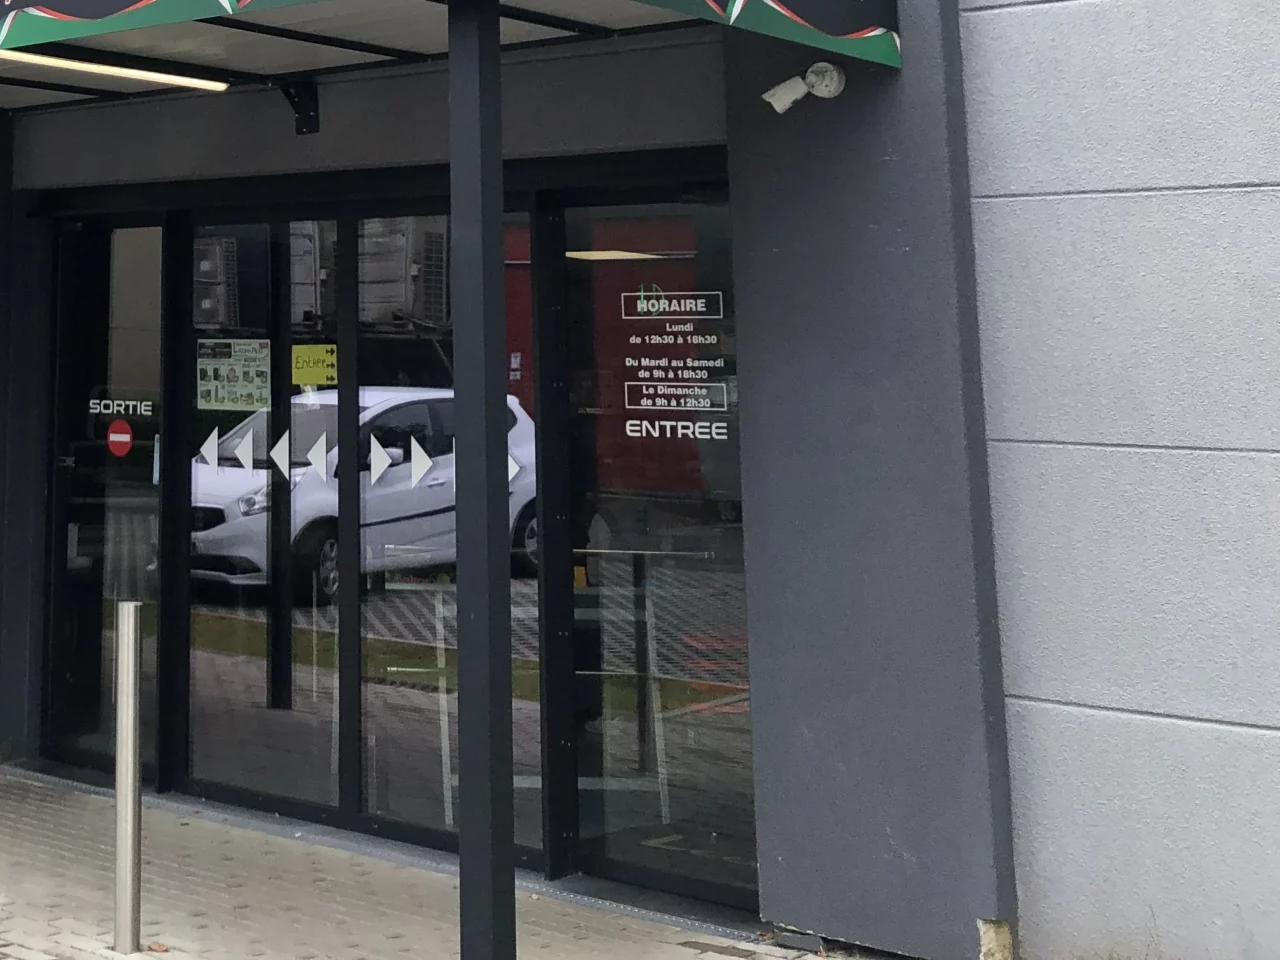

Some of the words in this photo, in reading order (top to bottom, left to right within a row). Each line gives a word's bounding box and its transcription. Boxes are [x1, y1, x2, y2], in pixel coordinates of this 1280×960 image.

[636, 298, 707, 313] HORAIRE
[666, 323, 694, 331] Lundi
[629, 335, 642, 344] de
[644, 335, 675, 344] 12h30
[676, 335, 684, 344] à
[686, 335, 718, 344] 18h30
[625, 357, 639, 366] Du
[641, 357, 669, 367] Mardi
[686, 358, 725, 368] Samedi
[638, 369, 651, 378] de
[652, 369, 666, 378] 9h
[667, 369, 675, 379] à
[677, 370, 709, 379] 18h30
[642, 385, 655, 394] Le
[657, 385, 708, 396] Dimanche
[89, 399, 152, 415] SORTIE
[640, 397, 653, 406] de
[655, 397, 669, 406] 9h
[670, 397, 678, 407] à
[680, 398, 711, 408] 12h30
[625, 420, 728, 440] ENTREE
